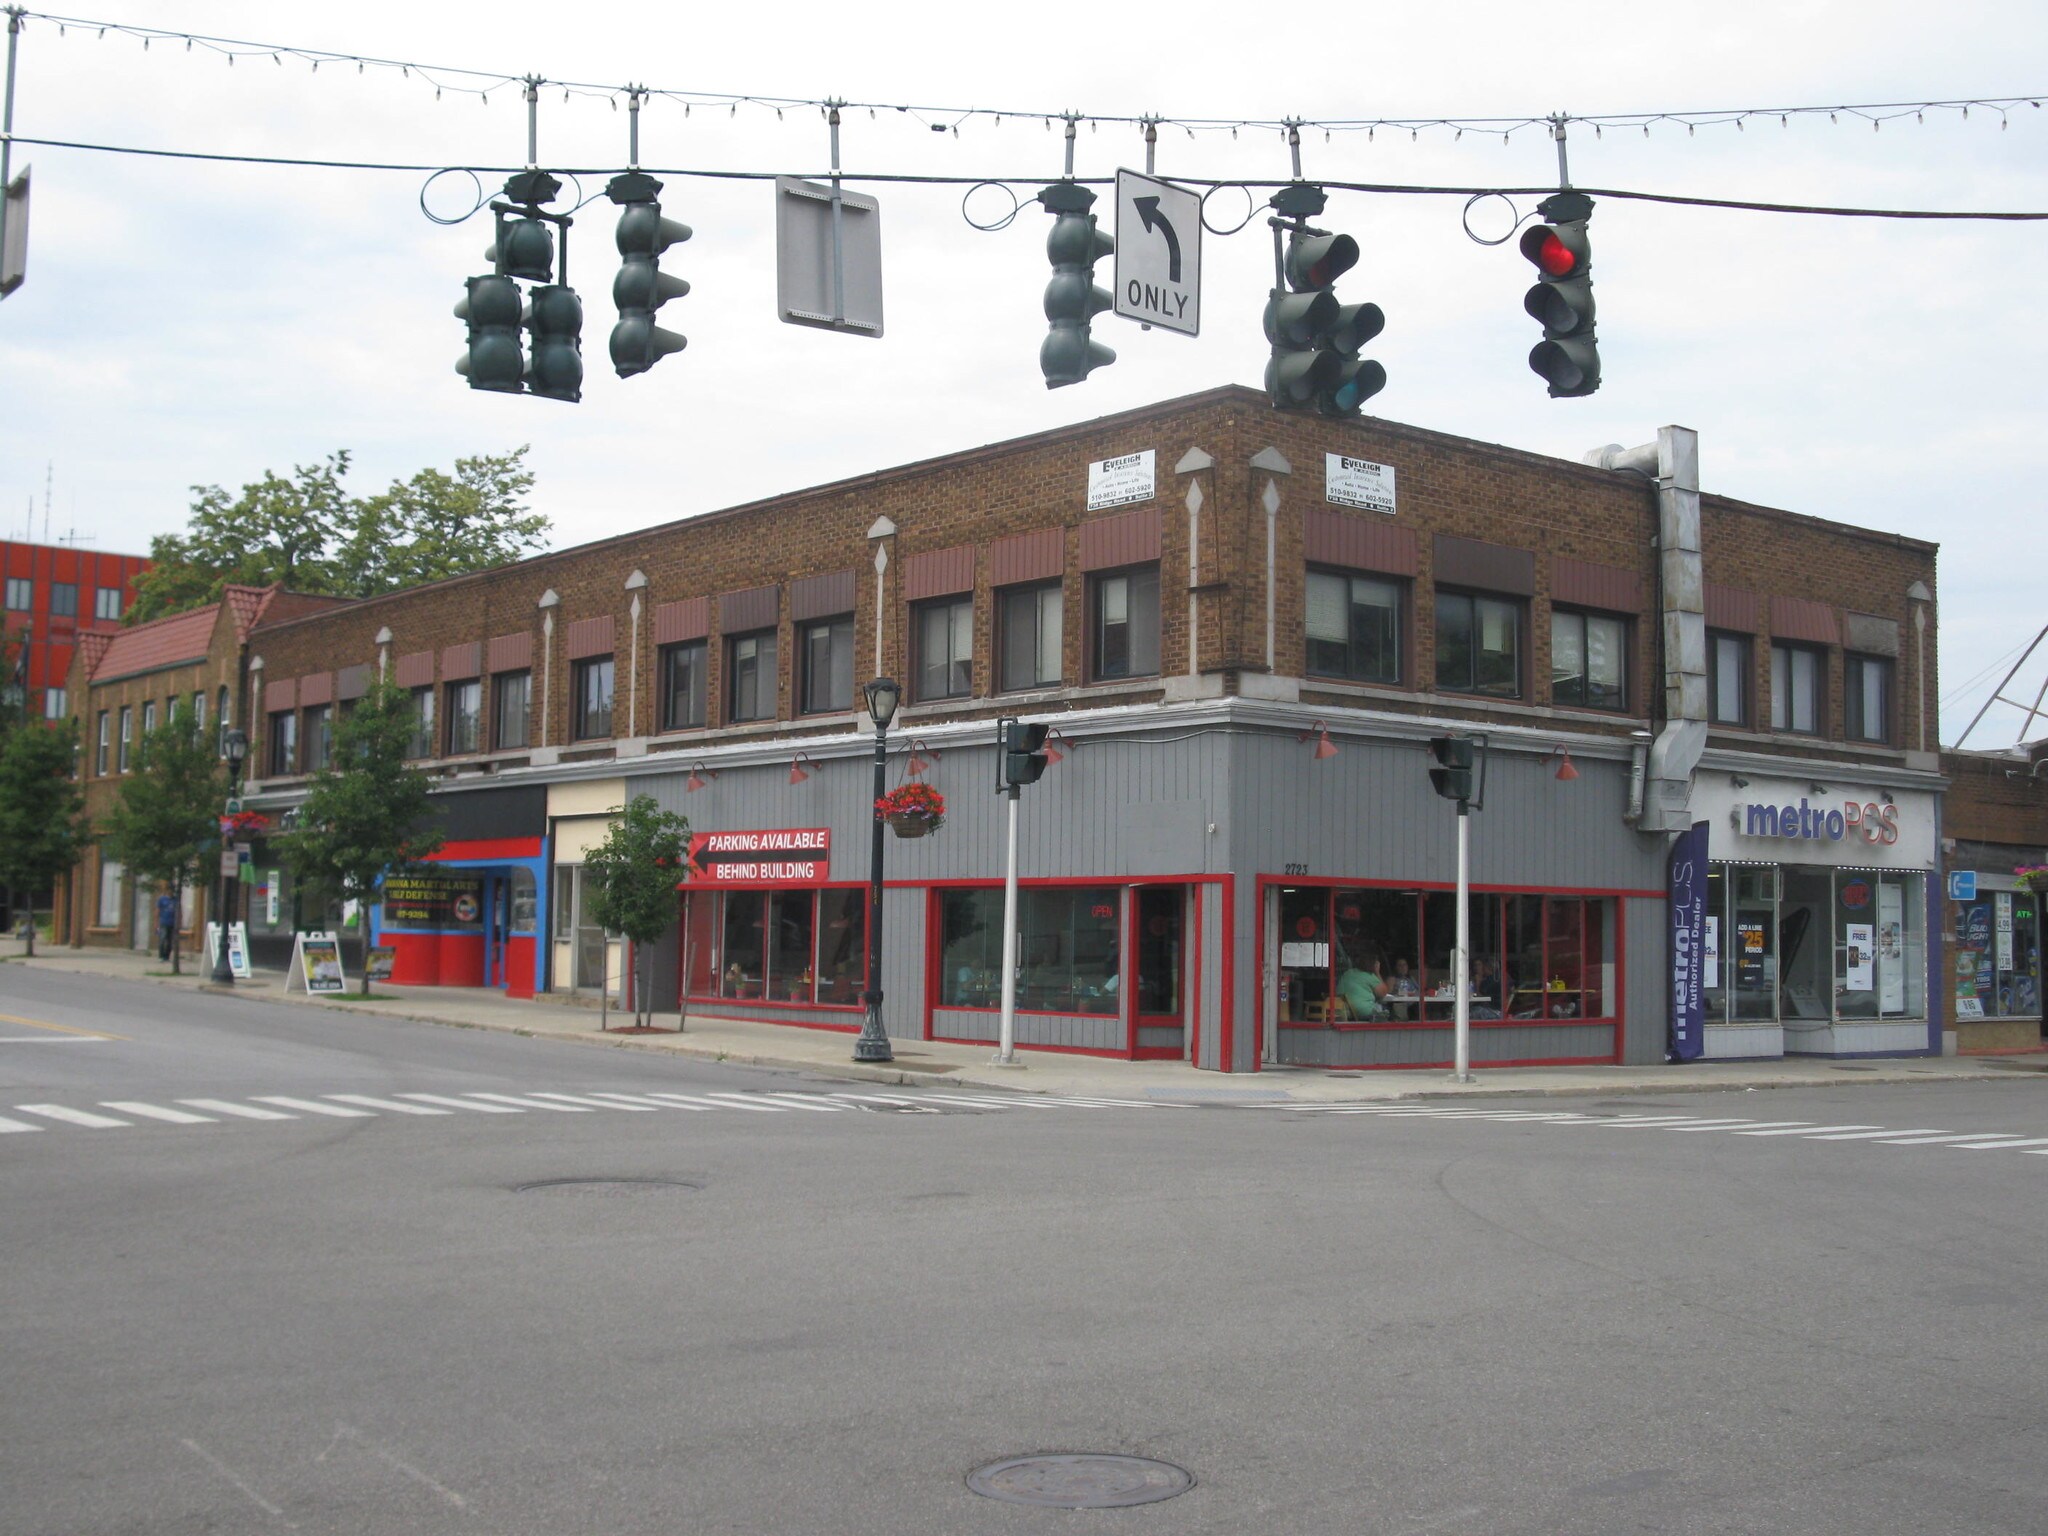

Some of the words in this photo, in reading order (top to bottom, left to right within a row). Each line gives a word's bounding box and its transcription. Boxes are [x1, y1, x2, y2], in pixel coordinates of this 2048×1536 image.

[1128, 279, 1188, 319] ONLY
[1103, 454, 1141, 473] EVELEIGH
[1341, 457, 1381, 472] EVELEIGH
[1091, 490, 1117, 502] 510-9832
[1124, 483, 1152, 495] 602-5920
[1329, 487, 1358, 498] 510-9832
[1365, 494, 1393, 505] 602-5920
[1747, 797, 1899, 846] metroPCS
[708, 834, 759, 851] PARKING
[760, 831, 825, 849] AVAILABLE
[717, 863, 757, 879] BEHIND
[760, 862, 814, 879] BUILDING
[1285, 863, 1309, 876] 2723
[1690, 896, 1702, 938] Dealer
[1852, 932, 1867, 941] FREE
[1689, 941, 1699, 1011] Authorized
